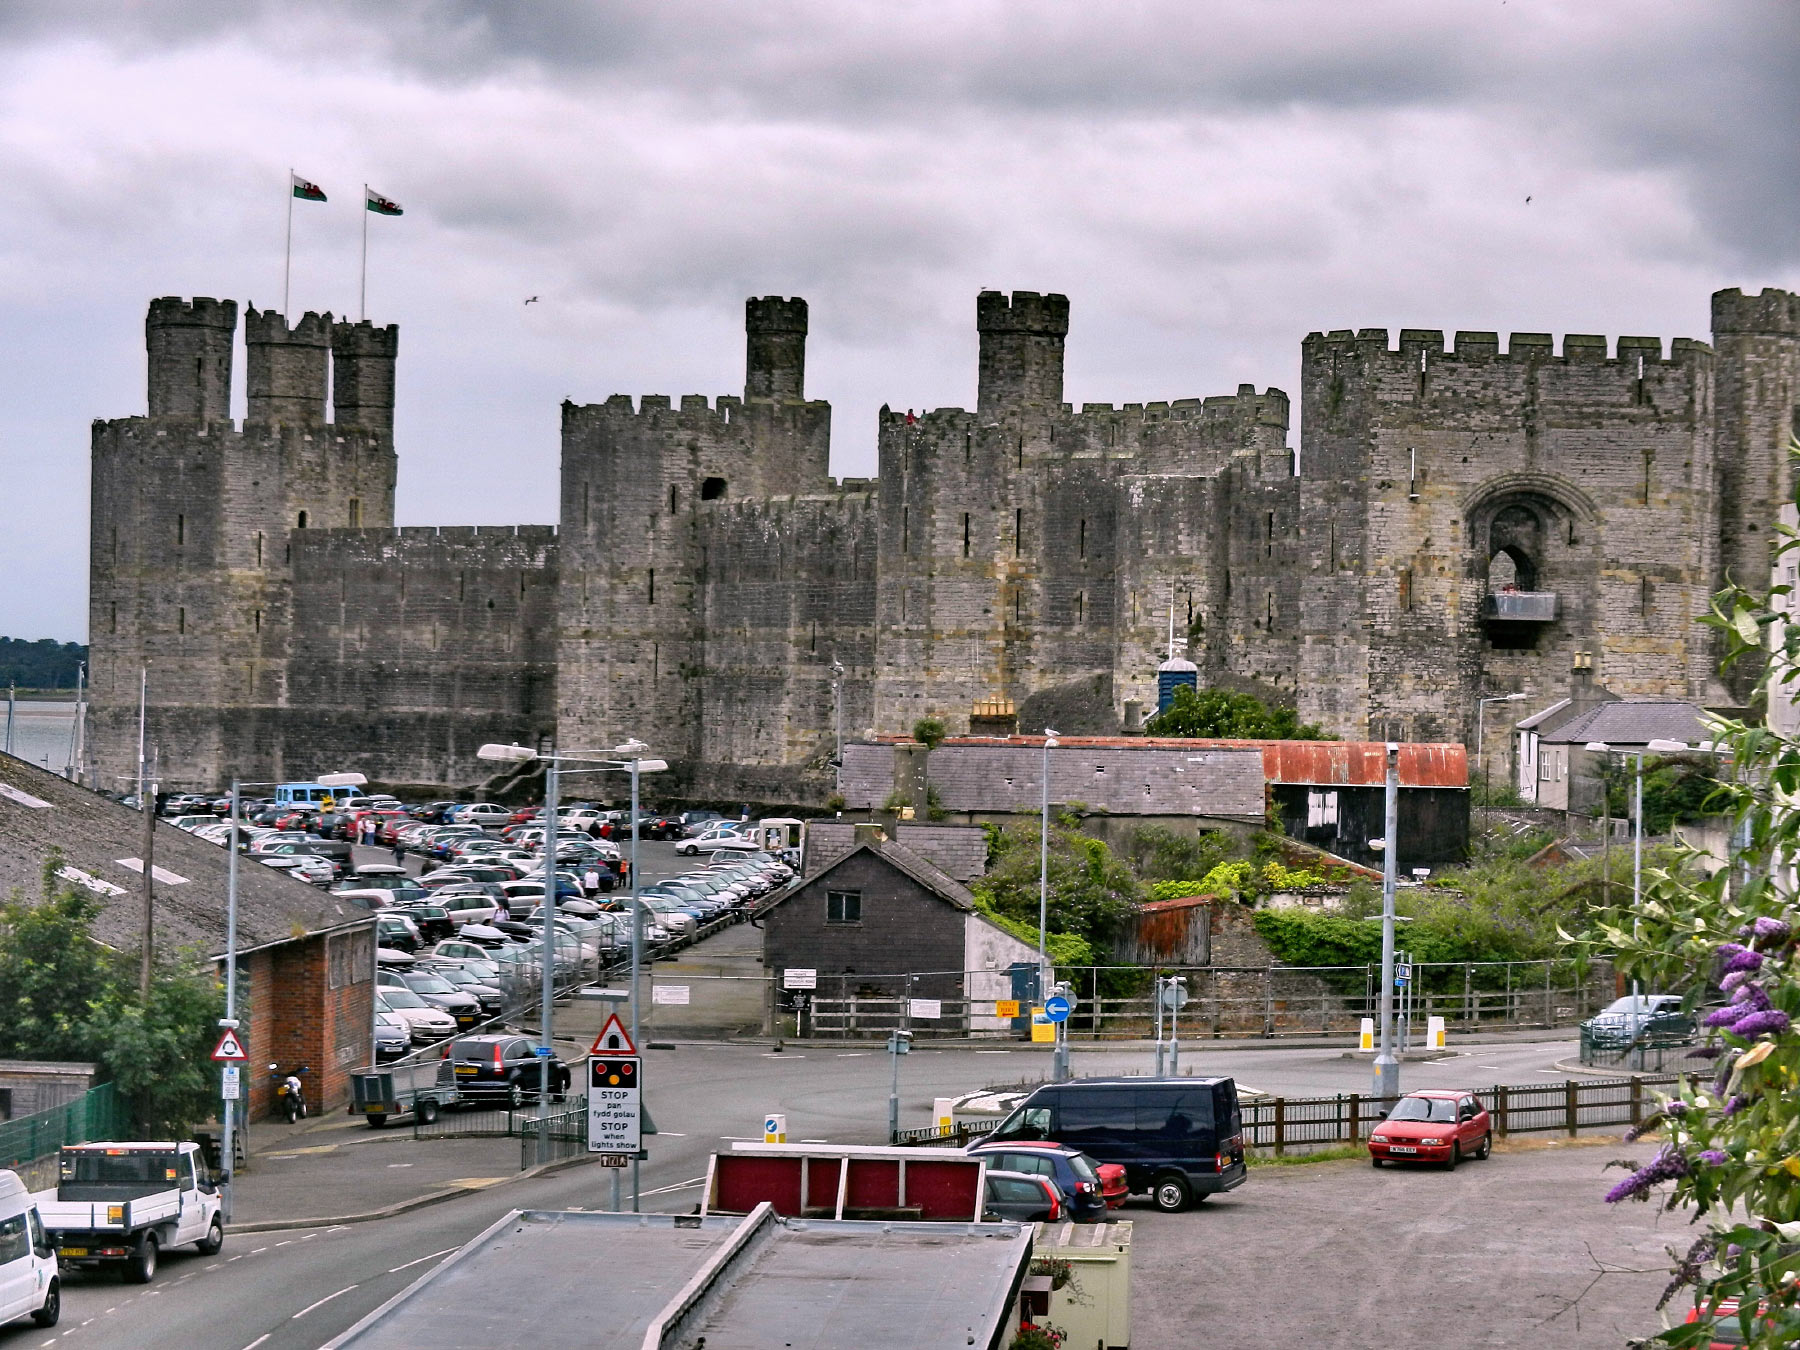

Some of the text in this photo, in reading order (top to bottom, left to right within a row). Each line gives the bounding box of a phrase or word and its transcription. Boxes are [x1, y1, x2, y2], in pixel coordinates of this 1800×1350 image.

[601, 1091, 629, 1099] STOP
[593, 1110, 611, 1118] fydd
[601, 1122, 629, 1131] STOP
[591, 1141, 614, 1149] lights
